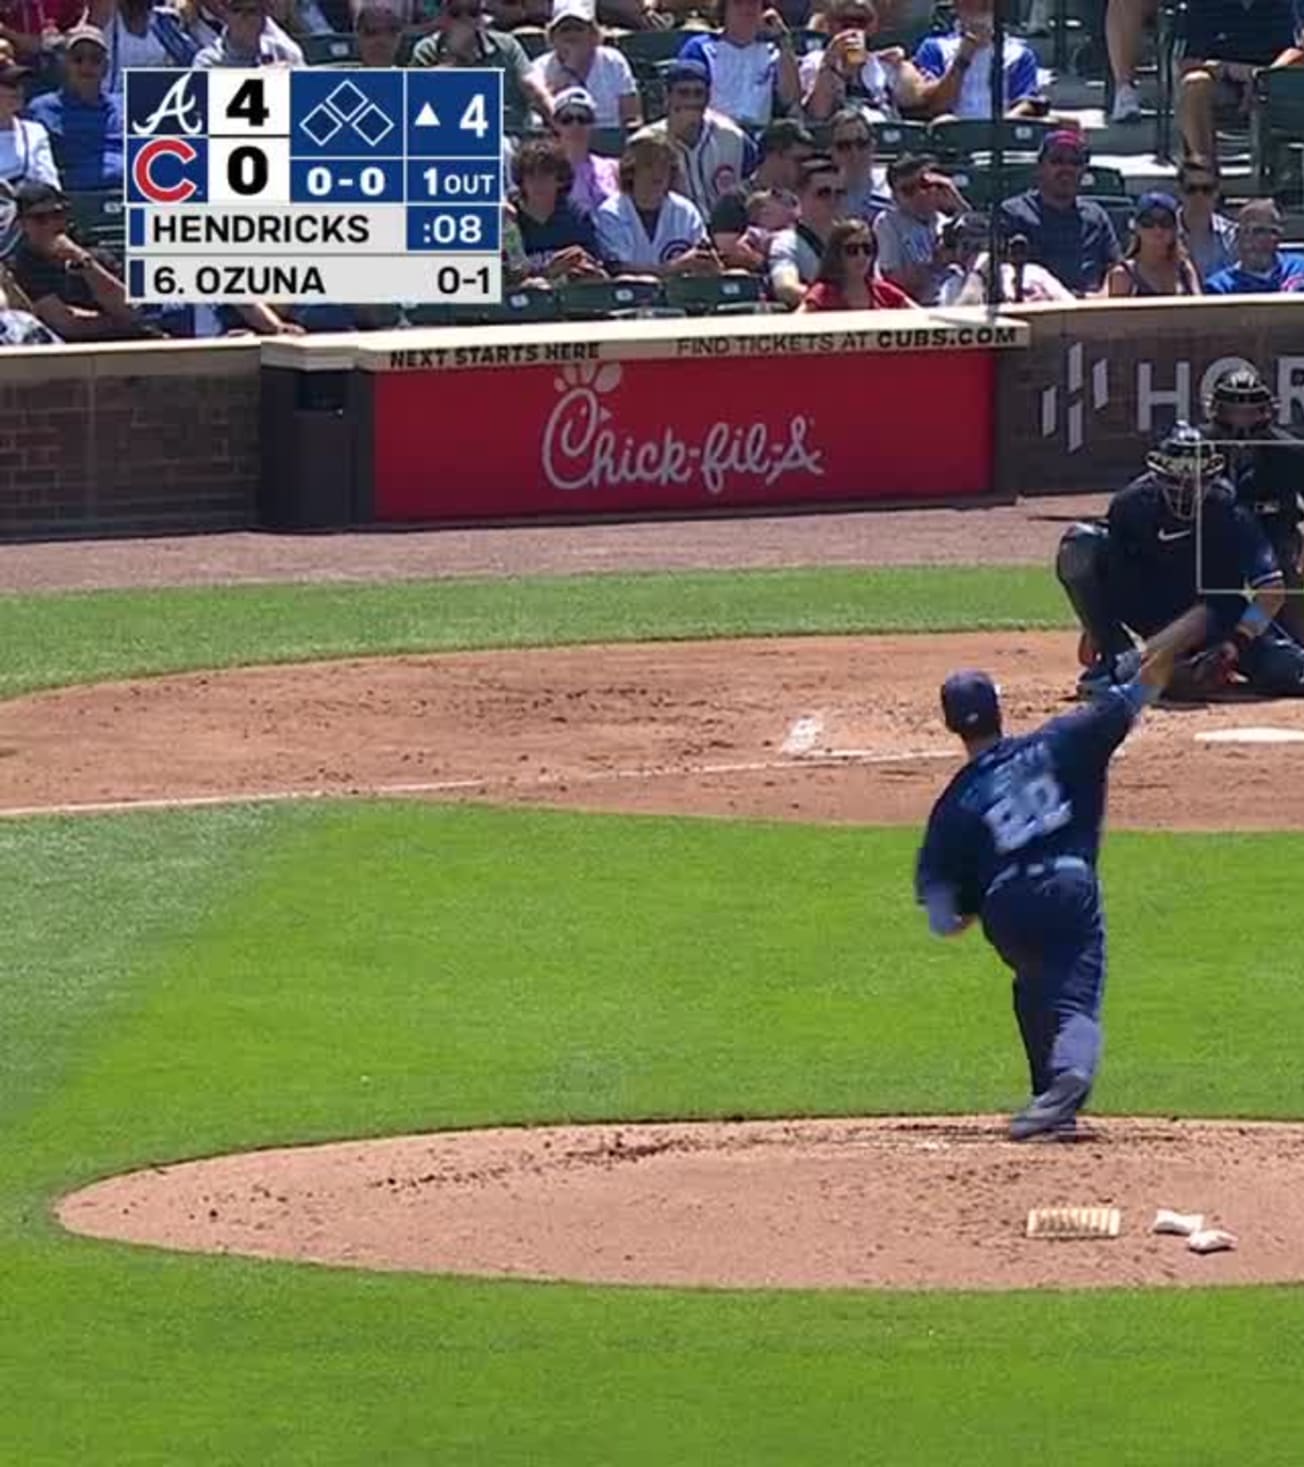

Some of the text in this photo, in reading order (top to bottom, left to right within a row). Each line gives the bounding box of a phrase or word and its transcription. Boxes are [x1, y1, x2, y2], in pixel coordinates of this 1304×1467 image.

[390, 342, 600, 369] NEXT STARTS HERE
[677, 327, 1017, 356] FIND TICKETS AT CUBS.COM
[542, 387, 824, 494] Chick-fil-A
